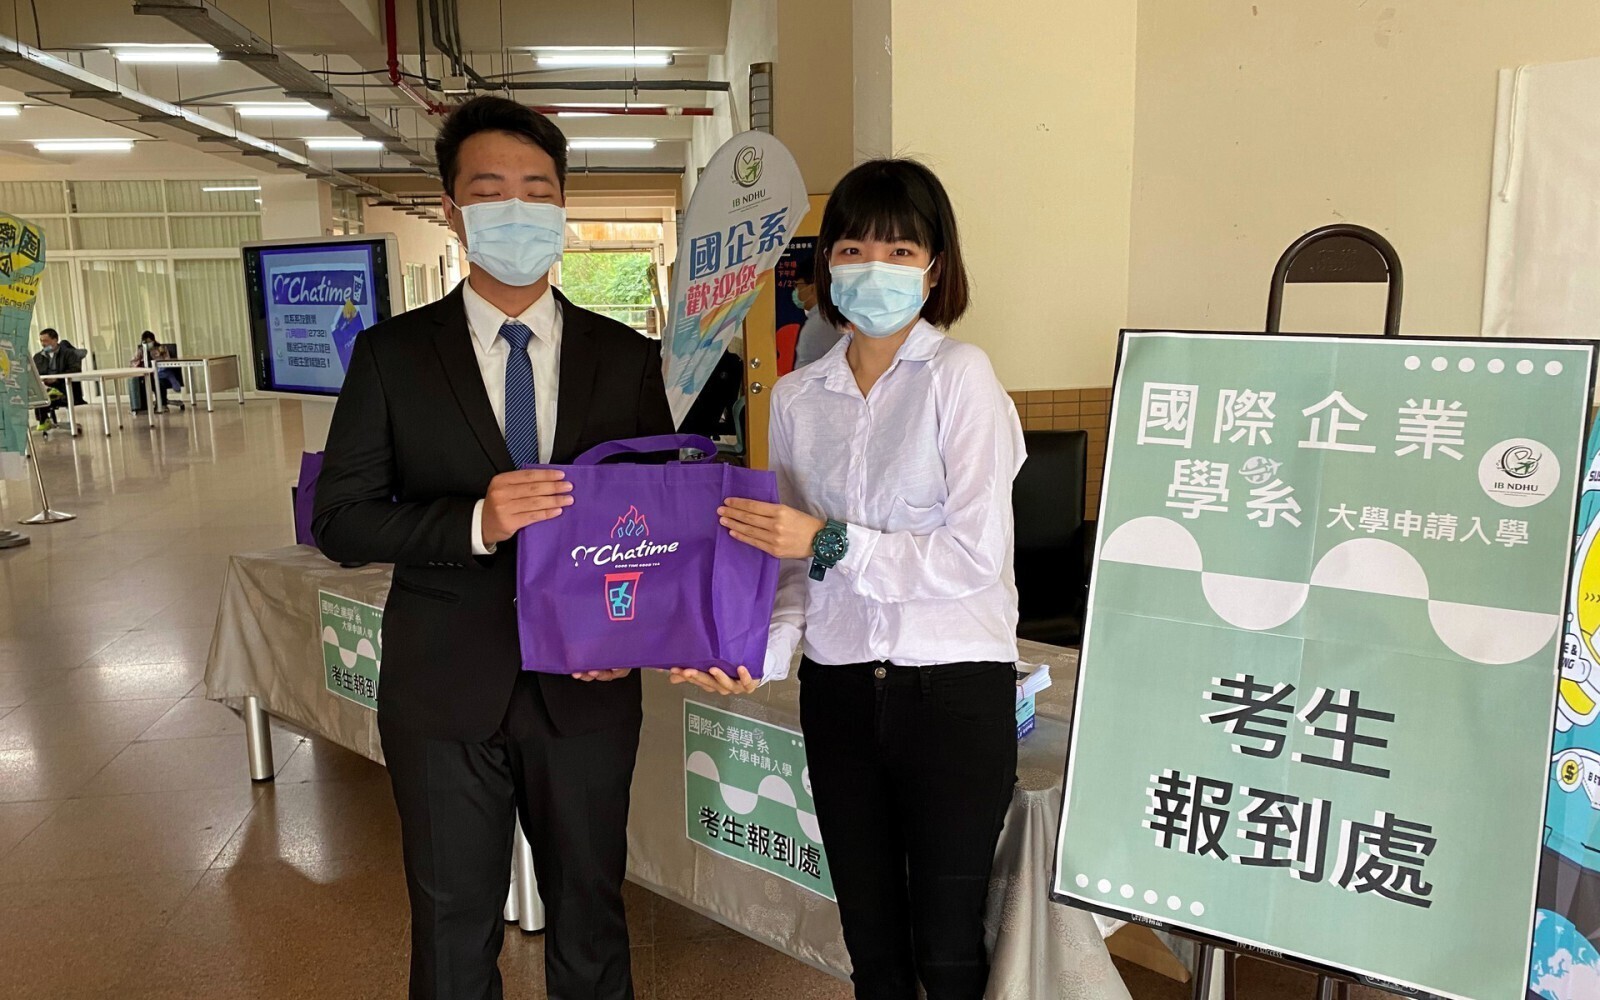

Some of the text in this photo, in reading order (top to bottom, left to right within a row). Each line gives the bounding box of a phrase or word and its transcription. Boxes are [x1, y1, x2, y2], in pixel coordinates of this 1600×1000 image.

[732, 198, 741, 208] IB
[742, 189, 766, 204] NDHU
[689, 206, 789, 281] 國企系
[288, 275, 351, 304] Chatime
[685, 263, 757, 317] 歡迎您
[1136, 381, 1468, 461] 國際企業
[1165, 458, 1302, 528] 學系
[1507, 483, 1538, 492] NDHU
[1326, 503, 1530, 548] 大學申請入學
[593, 540, 679, 566] Chatime
[688, 713, 770, 755] 國際企業學系
[1200, 673, 1396, 779] 考生
[729, 746, 793, 777] 大學申請入學
[699, 806, 821, 880] 考生報到處
[1142, 768, 1438, 908] 報到處
